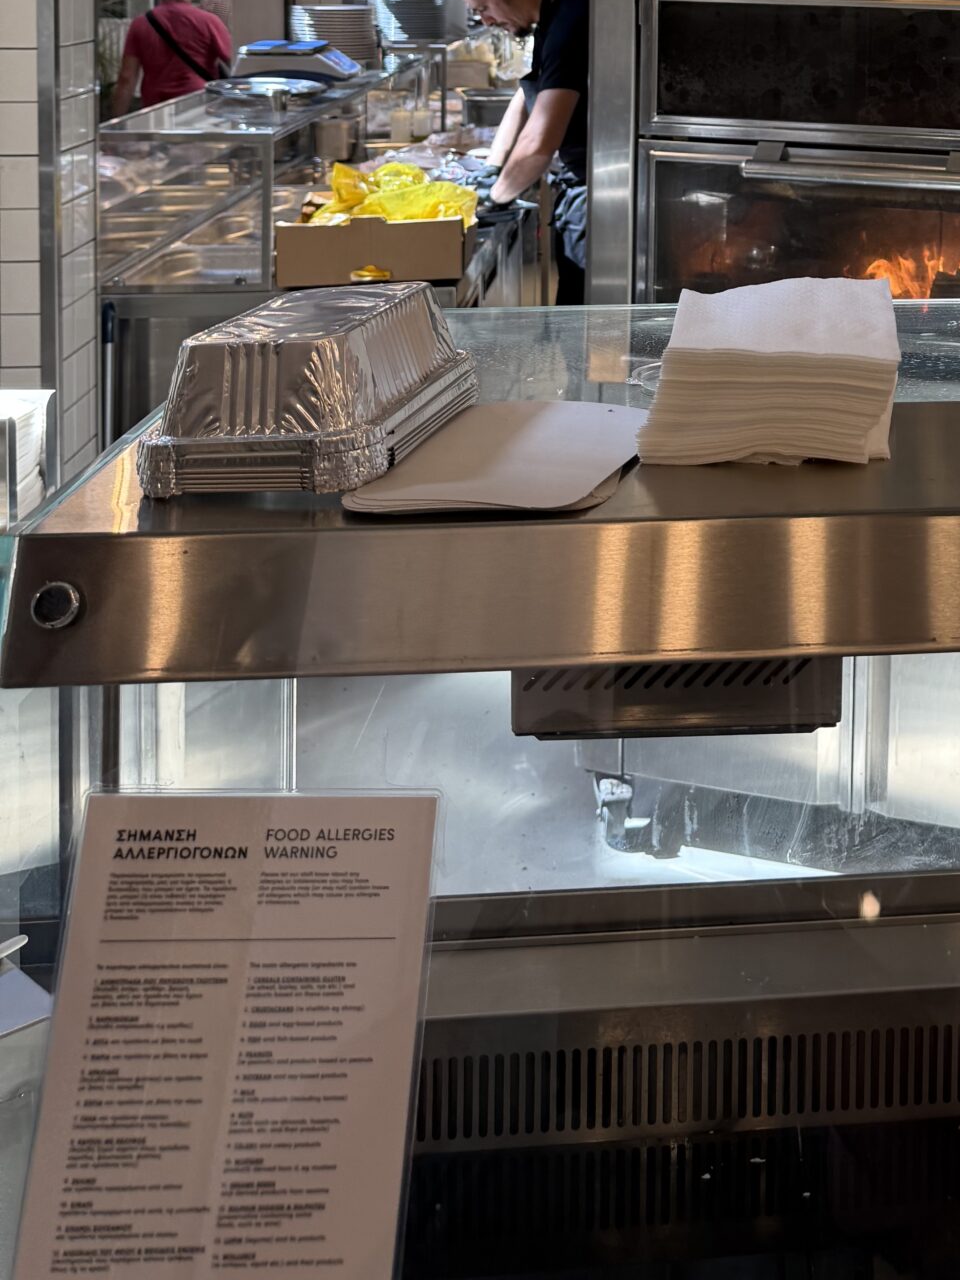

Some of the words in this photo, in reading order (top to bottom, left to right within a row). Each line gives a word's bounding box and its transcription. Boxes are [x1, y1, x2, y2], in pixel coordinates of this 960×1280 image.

[116, 829, 197, 841] ΣΗΜΑΝΣΗ
[266, 828, 310, 841] FOOD
[316, 828, 395, 841] ALLERGIES
[113, 846, 248, 860] ΑΛΛΕΡΓΙΟΓΟΝΩΝ
[265, 846, 338, 859] WARNING
